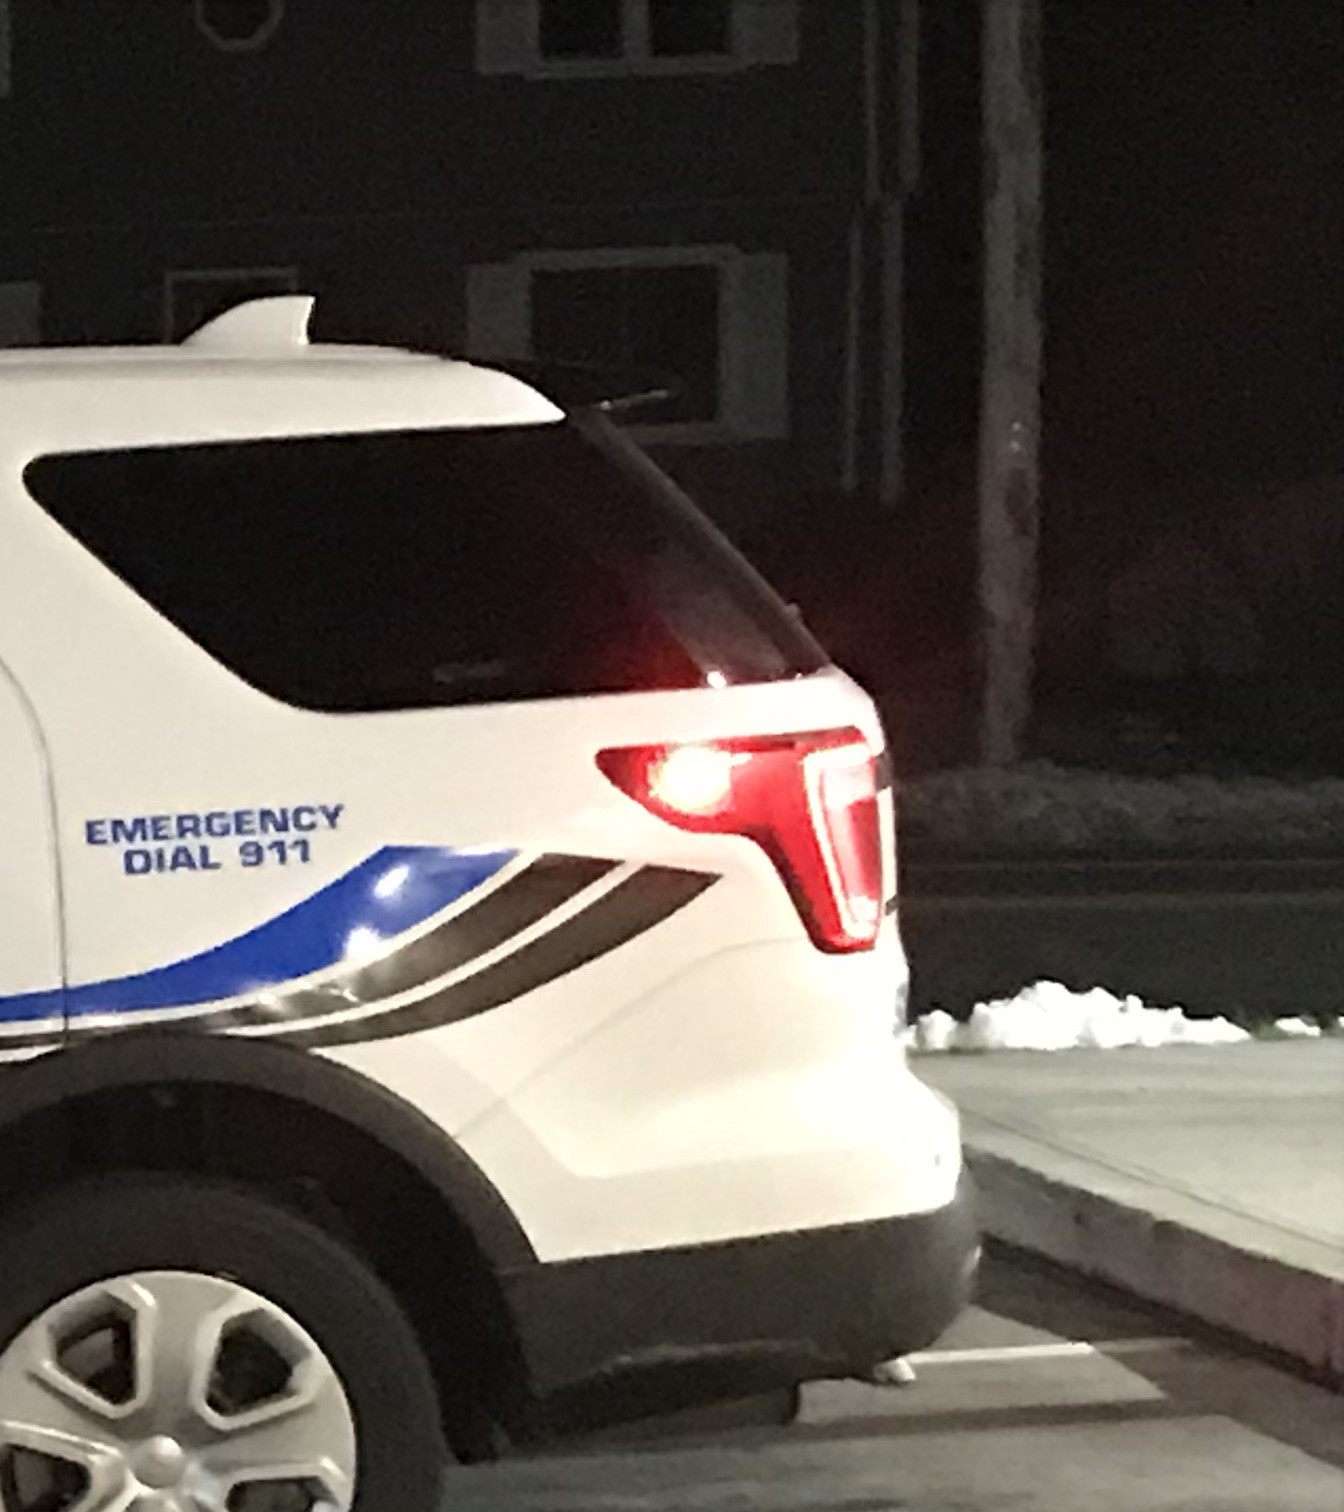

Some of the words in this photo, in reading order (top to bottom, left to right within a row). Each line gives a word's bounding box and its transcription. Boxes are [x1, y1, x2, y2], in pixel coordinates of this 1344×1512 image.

[85, 804, 344, 845] EMERGENCY
[123, 845, 221, 875] DIAL
[239, 838, 311, 868] 911
